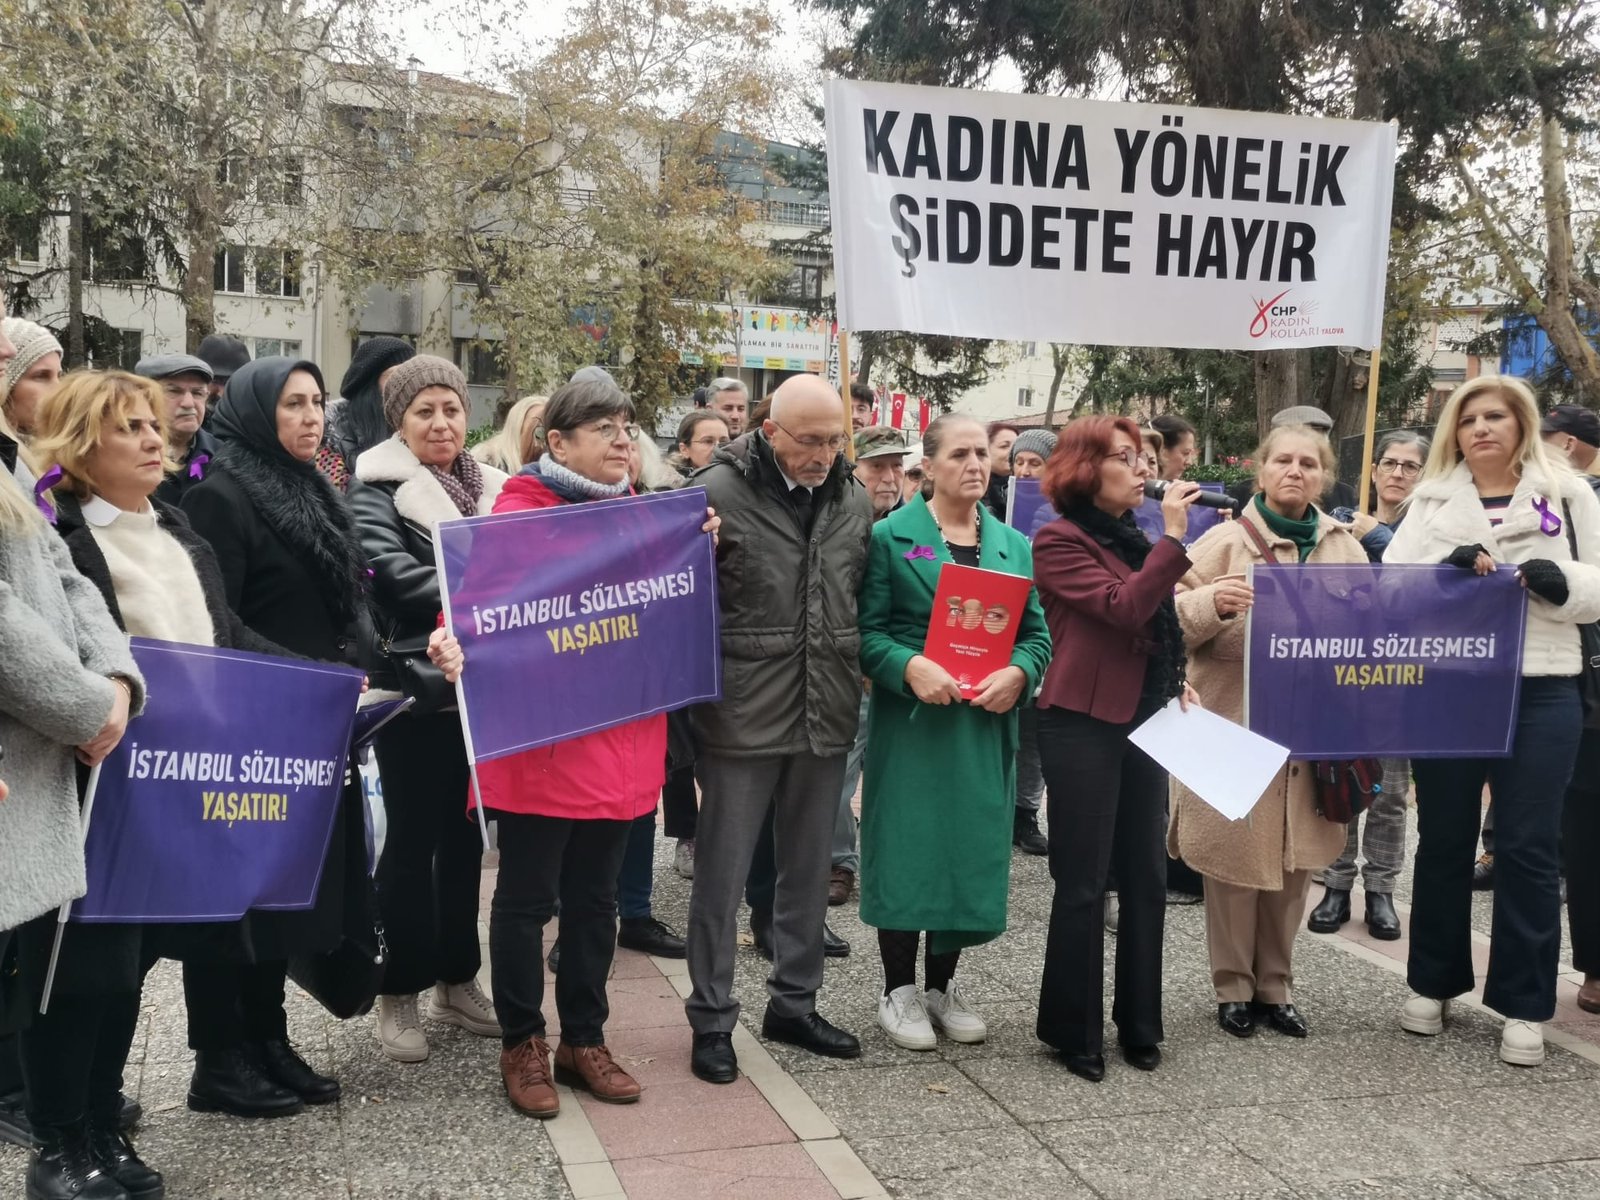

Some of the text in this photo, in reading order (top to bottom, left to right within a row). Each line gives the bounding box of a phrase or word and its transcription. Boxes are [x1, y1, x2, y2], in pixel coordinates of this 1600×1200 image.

[863, 108, 1090, 191] KADINA
[1156, 213, 1317, 283] HAYIR
[1270, 316, 1311, 327] KADIN
[1271, 306, 1297, 317] CHP
[1270, 327, 1345, 339] KOLLARI YALOVA
[471, 565, 695, 636] İSTANBUL SÖZLEŞMESİ
[945, 596, 1011, 635] 100
[546, 613, 639, 656] YAŞATIR!
[1269, 633, 1495, 663] İSTANBUL SÖZLEŞMESİ
[1334, 664, 1424, 691] YAŞATIR!
[127, 742, 338, 793] İSTANBUL SÖZLEŞMESİ
[202, 792, 287, 828] YAŞATIR!
